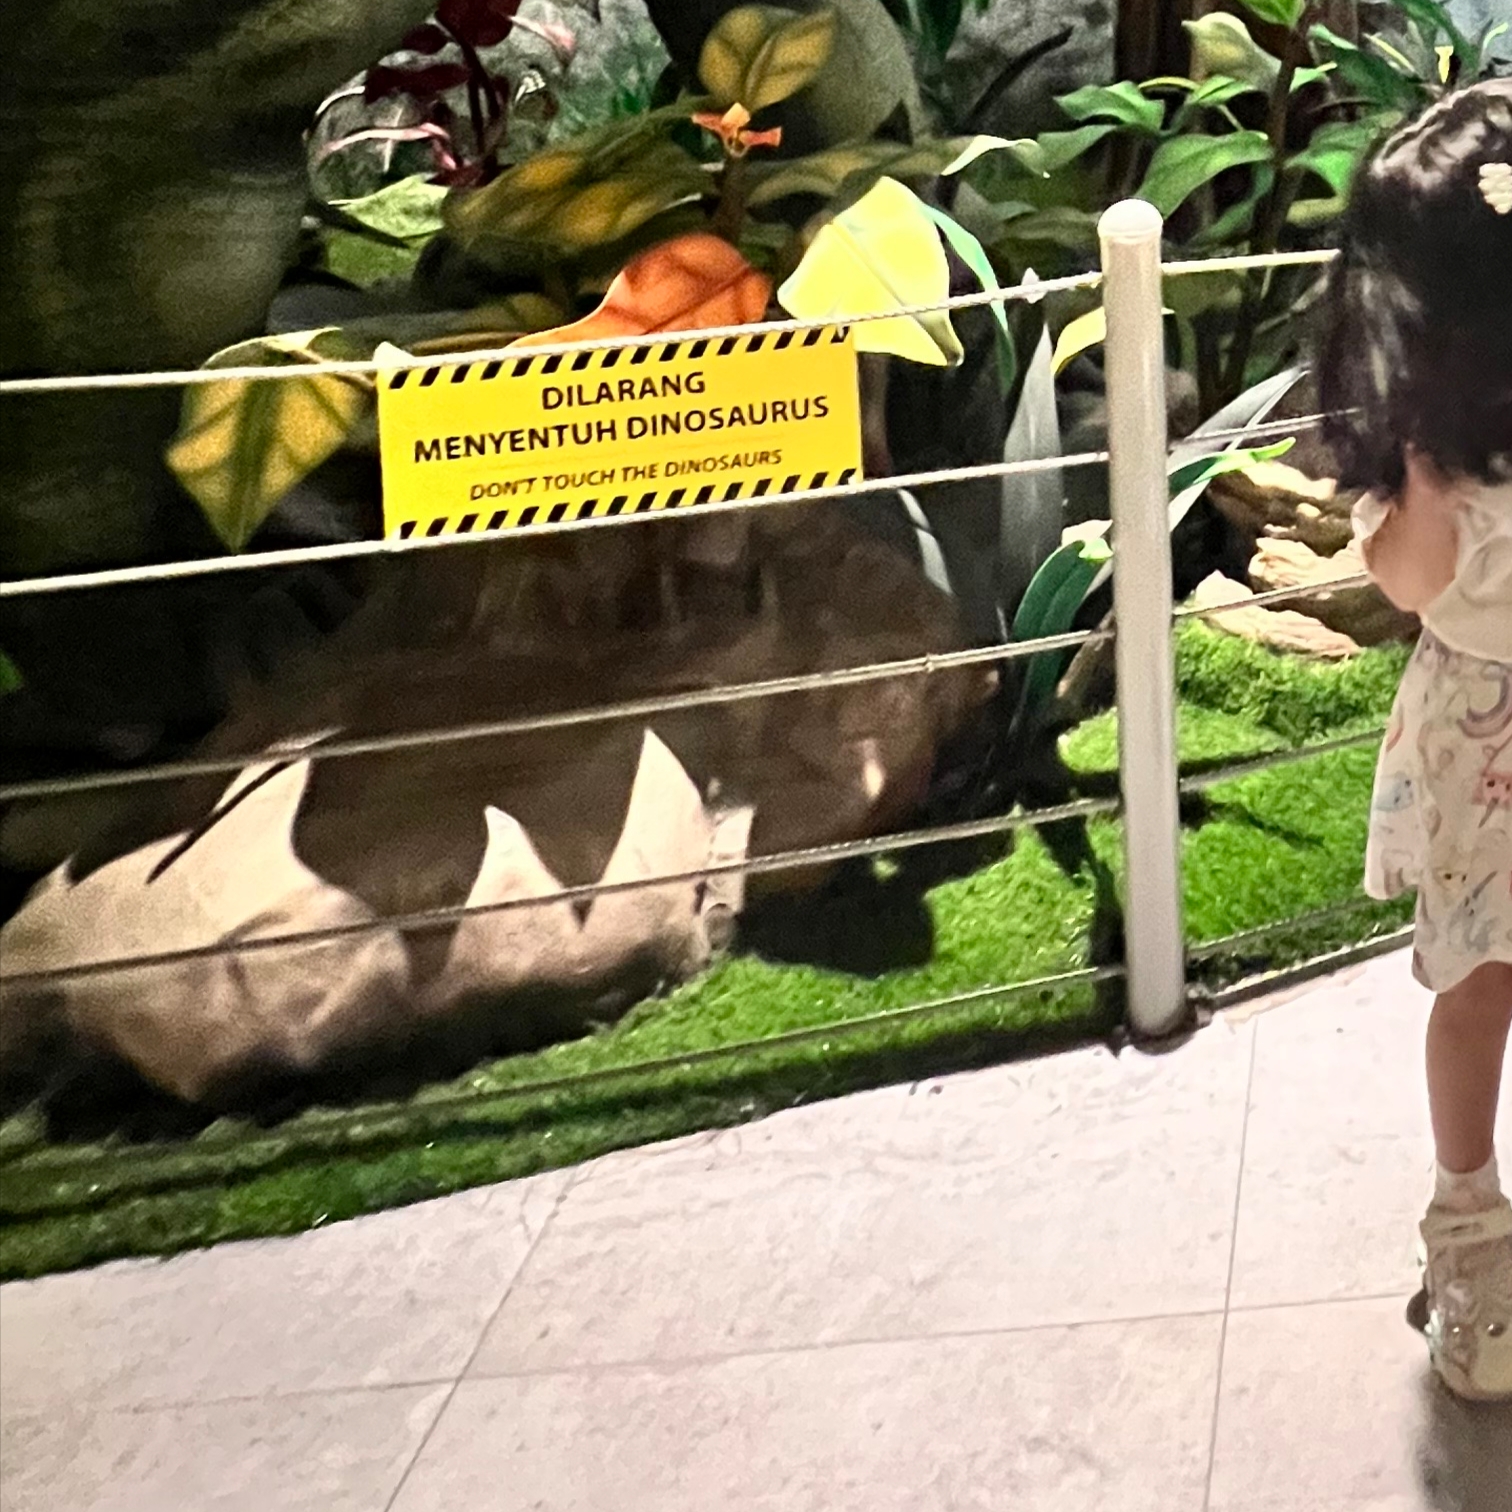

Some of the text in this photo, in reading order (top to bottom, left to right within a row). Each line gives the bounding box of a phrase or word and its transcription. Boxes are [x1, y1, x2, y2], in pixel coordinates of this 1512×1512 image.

[541, 371, 706, 410] DILARANG
[413, 395, 830, 463] MENYENTUH DINOSAURUS
[469, 449, 783, 501] DON'T TOUCH THE DINOSAURS
